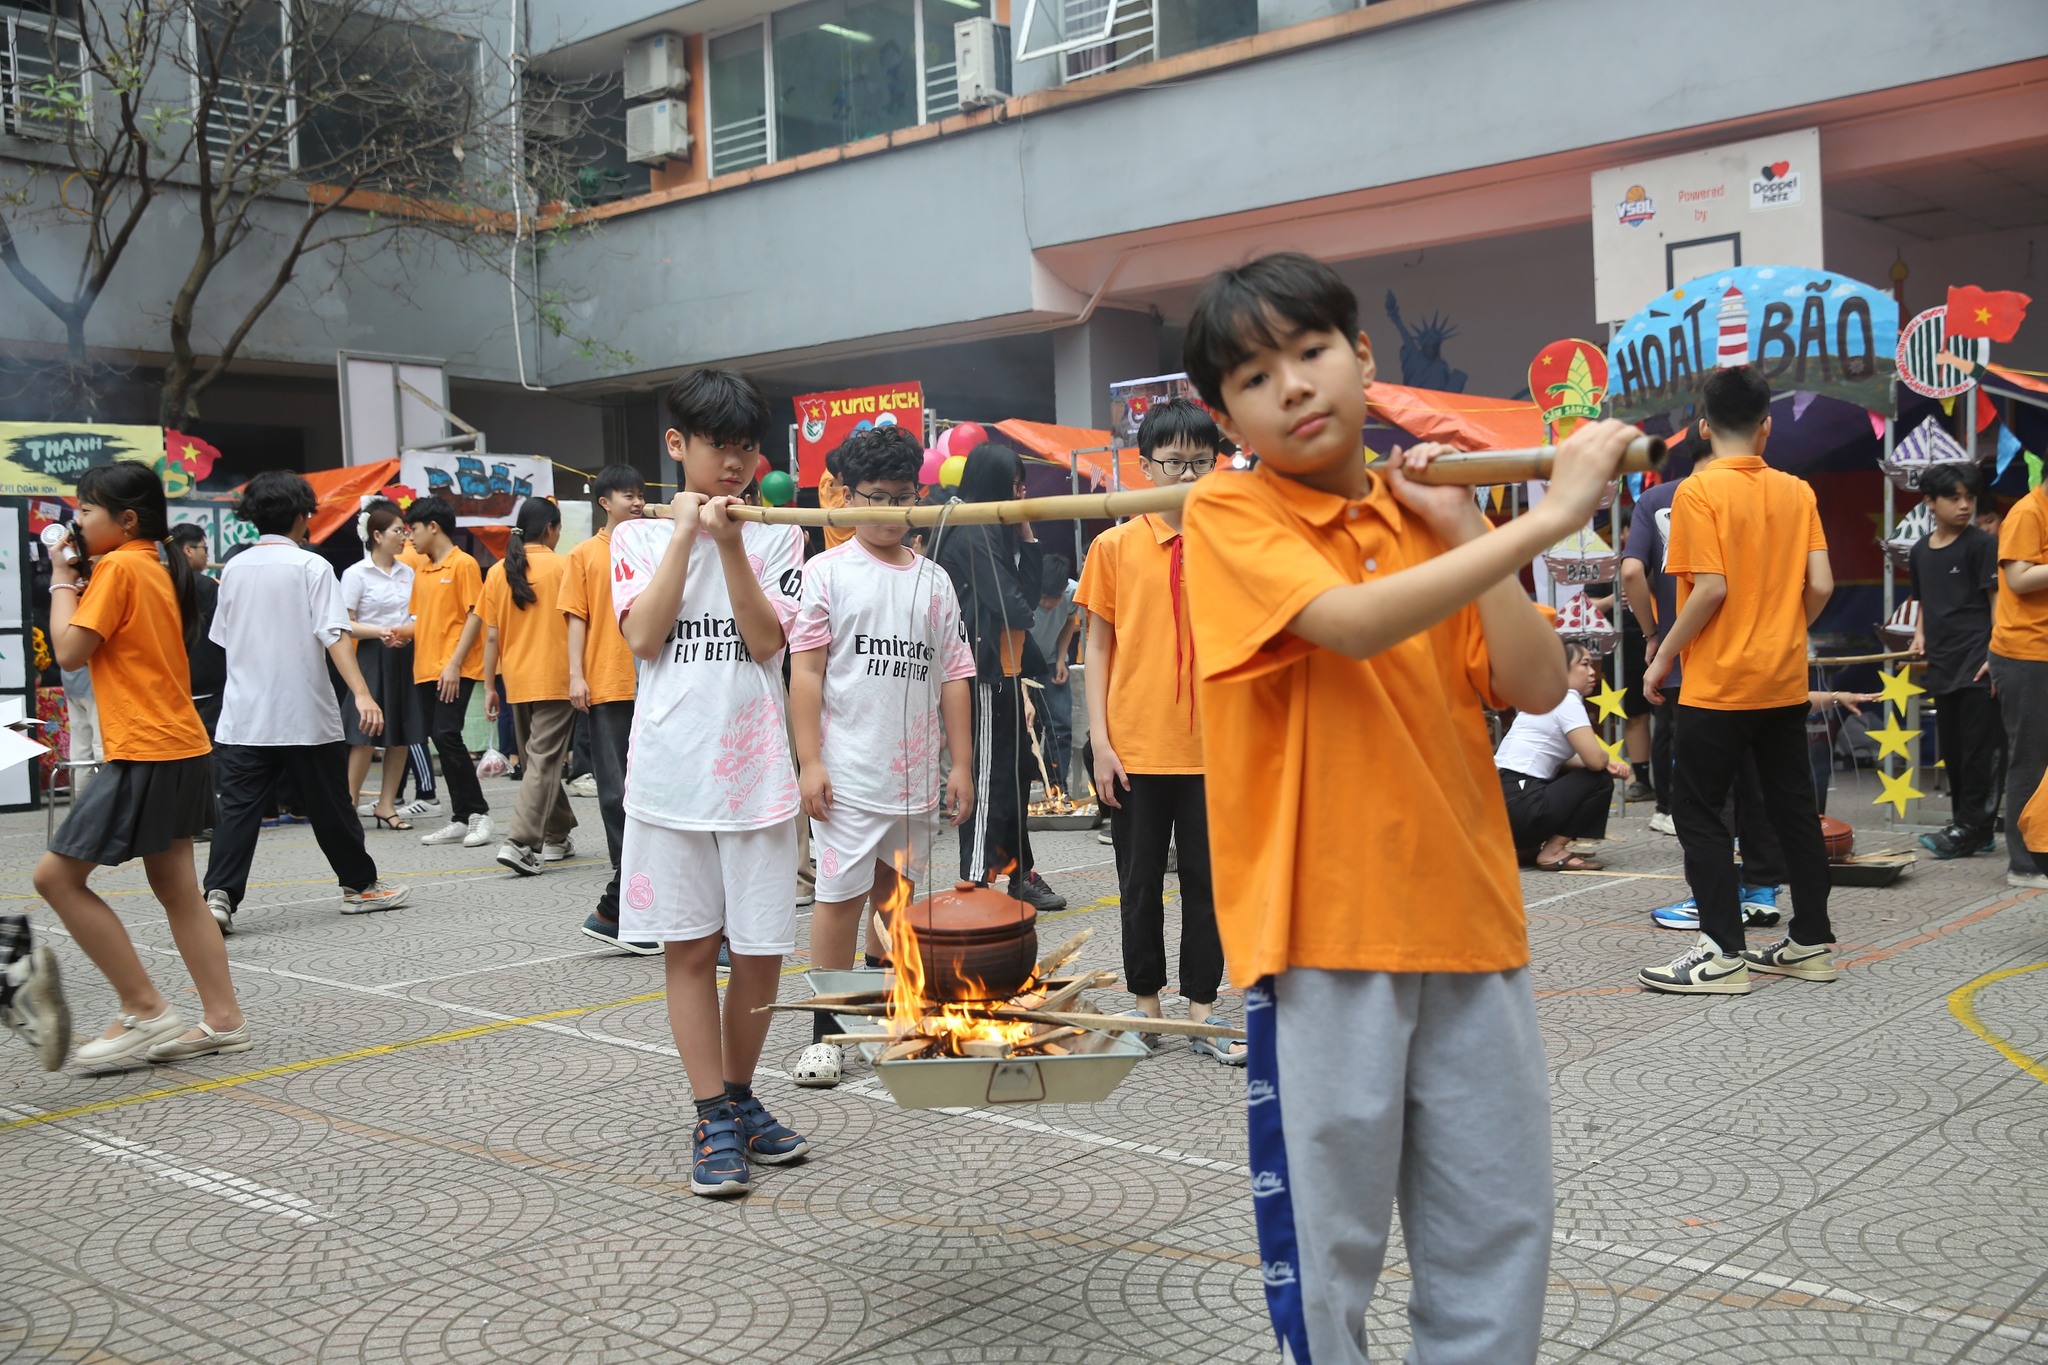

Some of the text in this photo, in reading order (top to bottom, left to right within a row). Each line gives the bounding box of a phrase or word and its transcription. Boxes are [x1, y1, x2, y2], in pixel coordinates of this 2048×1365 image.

[1678, 184, 1725, 203] Powered
[1753, 176, 1797, 194] Doppel
[1616, 199, 1656, 217] VSBL
[1694, 208, 1707, 223] by
[1756, 279, 1875, 383] BÃO
[878, 390, 920, 411] KÍCH
[25, 436, 102, 461] THANH
[43, 454, 89, 473] XUÂN
[674, 642, 700, 664] FLY
[854, 634, 936, 661] Emirates
[867, 659, 929, 682] FLY BETTER
